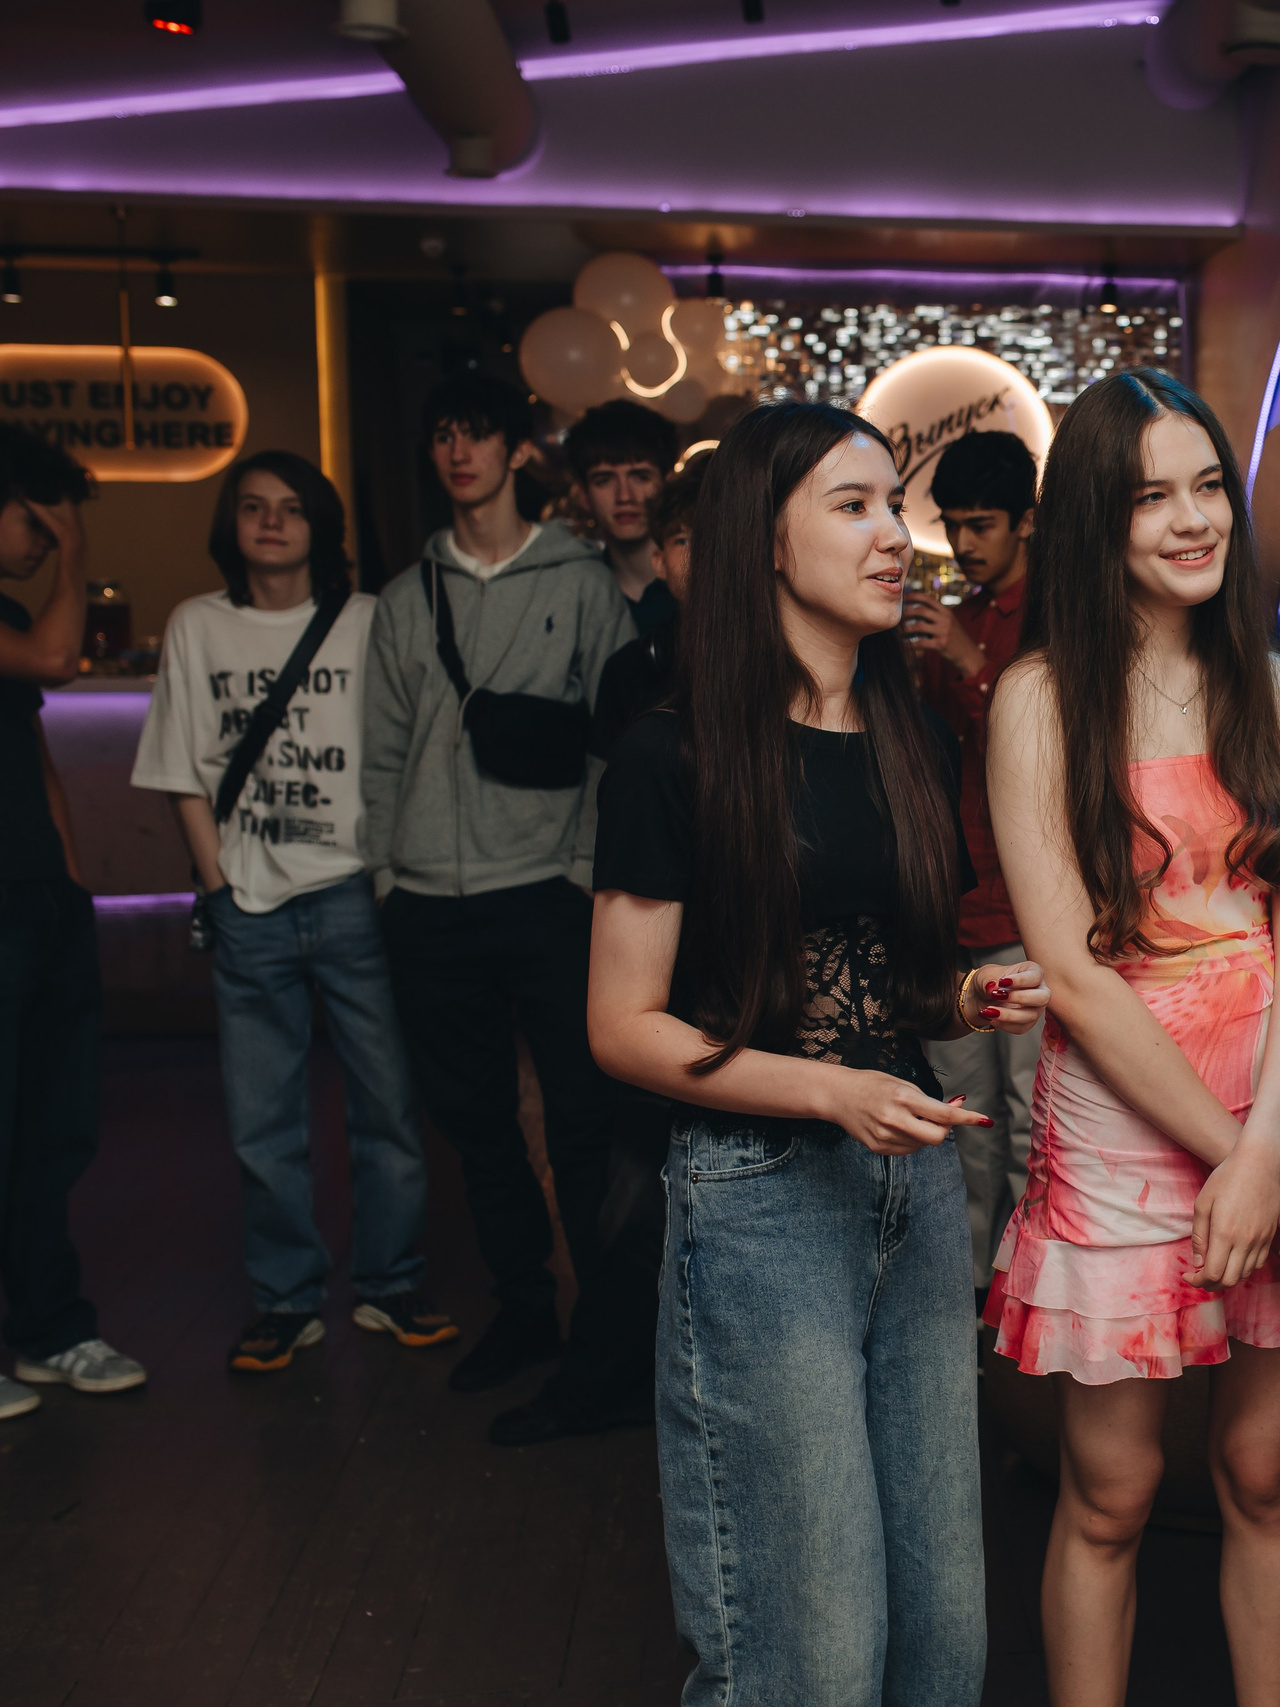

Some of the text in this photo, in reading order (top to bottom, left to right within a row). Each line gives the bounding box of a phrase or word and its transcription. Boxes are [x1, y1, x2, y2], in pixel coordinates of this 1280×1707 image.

[0, 380, 75, 409] UST
[136, 421, 234, 448] HERE
[209, 671, 233, 700] IT
[247, 668, 277, 697] IS
[218, 706, 310, 739] ABT
[267, 739, 346, 773] SING
